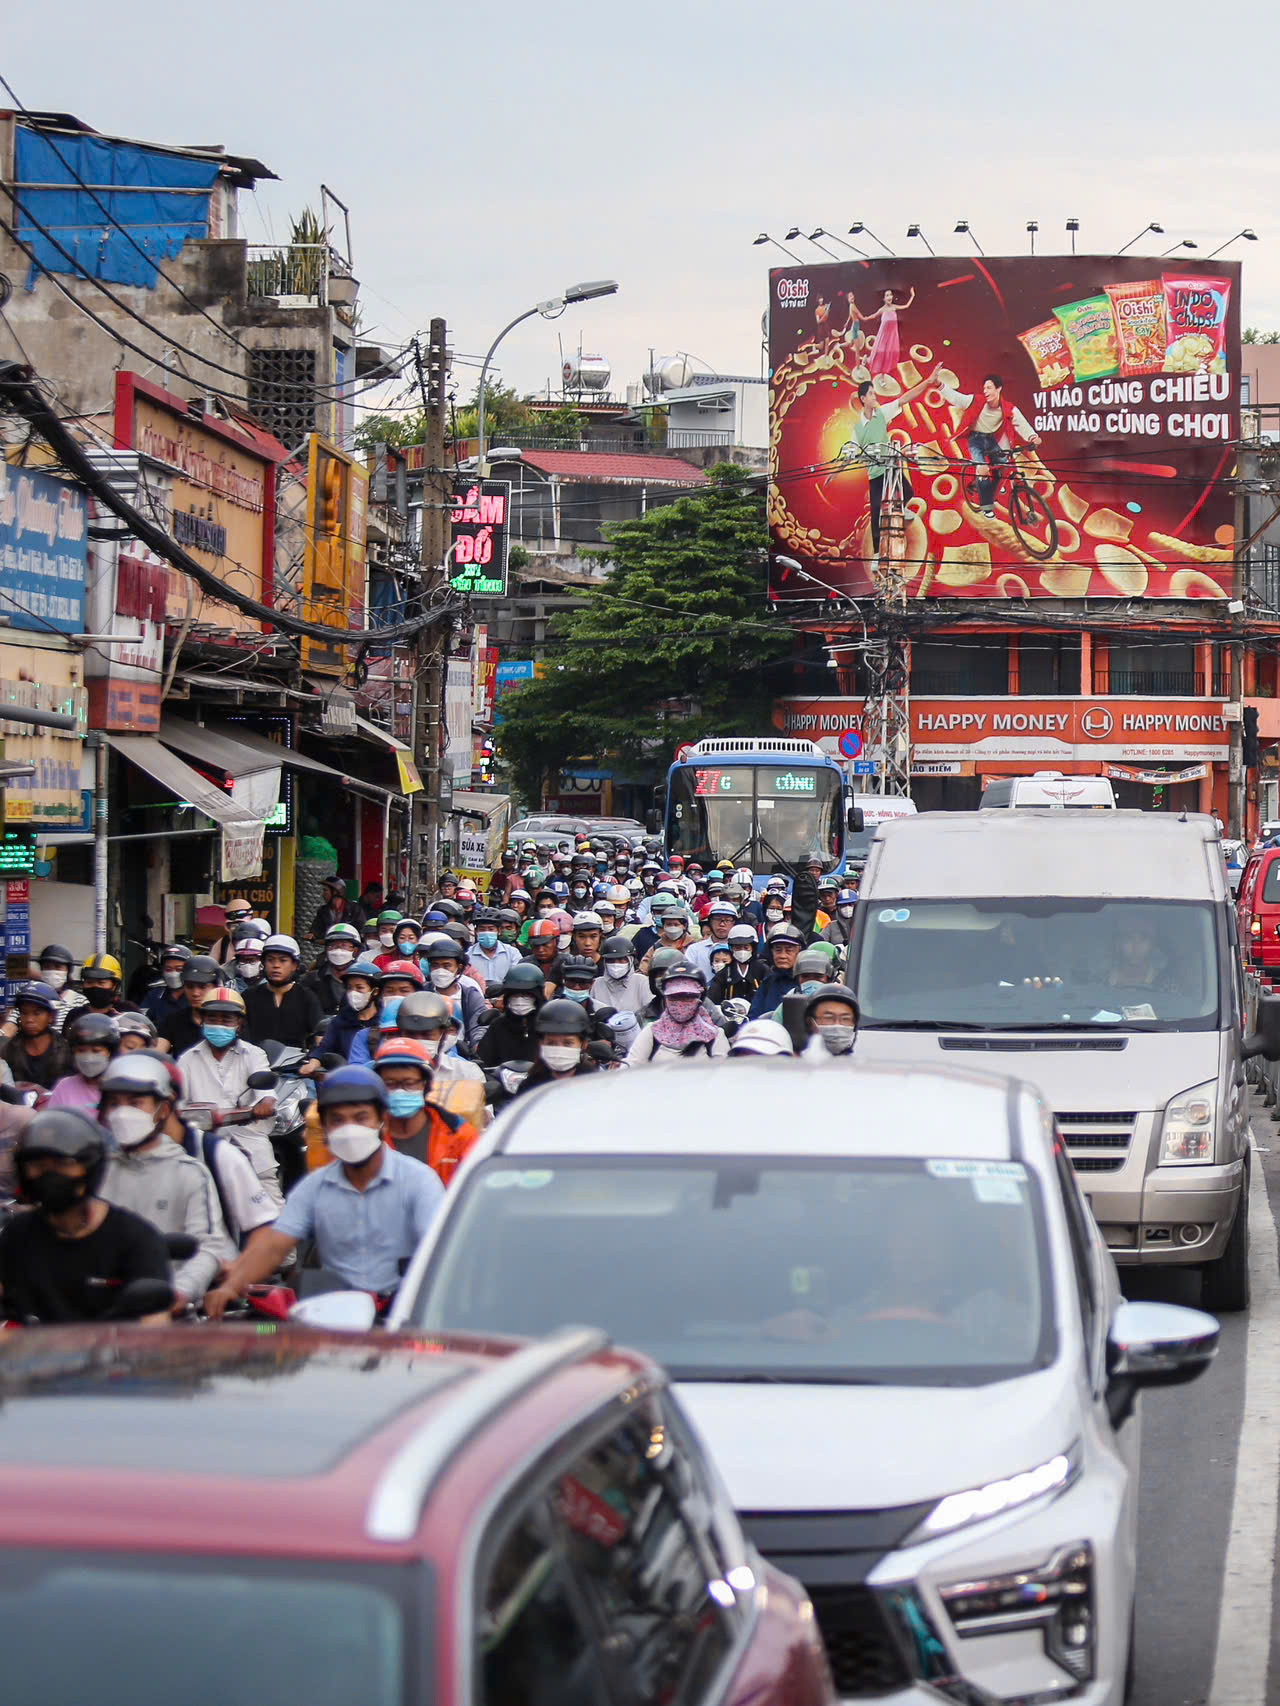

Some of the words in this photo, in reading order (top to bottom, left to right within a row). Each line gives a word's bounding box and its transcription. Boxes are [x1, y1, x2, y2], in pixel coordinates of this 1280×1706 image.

[777, 278, 810, 300] Oishi
[1122, 301, 1155, 317] Oishi
[1033, 391, 1047, 412] VỊ
[1051, 384, 1083, 408] NÀO
[1088, 379, 1143, 404] CŨNG
[1150, 363, 1230, 403] CHIỀU
[1034, 411, 1063, 431] GIÂY
[1067, 410, 1101, 432] NÀO
[1105, 409, 1160, 435] CŨNG
[1168, 412, 1230, 440] CHƠI
[455, 525, 494, 565] ĐỒ
[791, 714, 818, 731] HAPPY
[820, 714, 864, 730] MONEY
[918, 713, 987, 731] HAPPY
[993, 713, 1069, 731] MONEY
[1122, 714, 1173, 731] HAPPY
[1175, 714, 1228, 732] MONEY
[928, 762, 952, 773] HIỂM
[695, 770, 722, 795] 27
[461, 838, 475, 851] SỬA
[476, 842, 485, 853] XE
